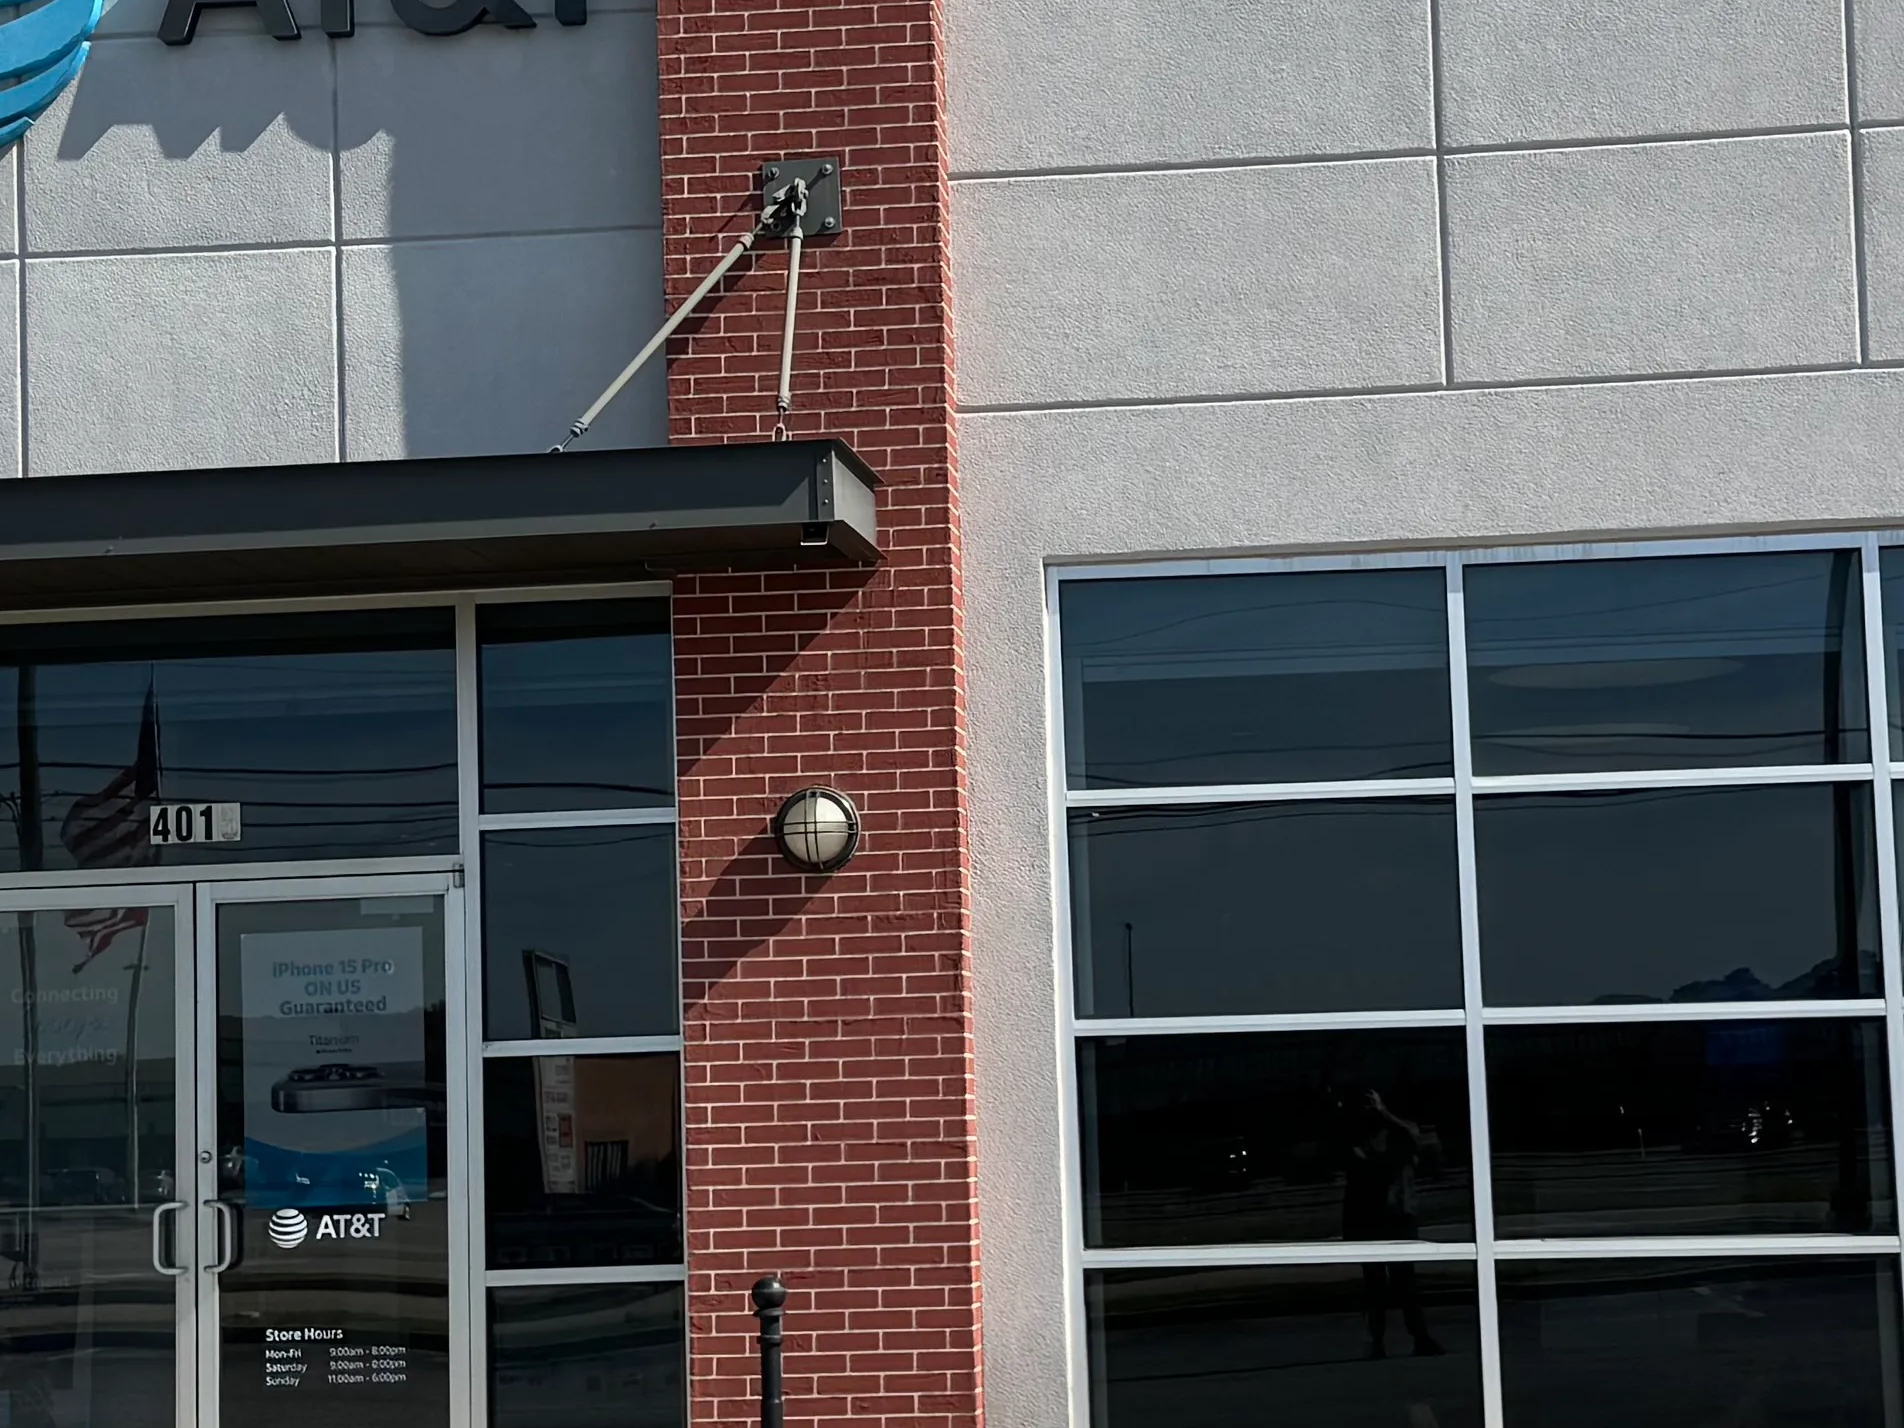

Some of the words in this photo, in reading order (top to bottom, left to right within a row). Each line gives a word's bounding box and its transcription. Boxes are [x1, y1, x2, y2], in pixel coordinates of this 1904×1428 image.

[152, 805, 213, 843] 401
[272, 959, 334, 979] iPhone
[338, 959, 357, 974] 15
[361, 958, 393, 974] Pro
[10, 985, 119, 1005] Connecting
[304, 981, 332, 997] ON
[337, 979, 361, 995] US
[279, 995, 387, 1016] Guaranteed
[13, 1045, 119, 1068] Everything
[315, 1213, 386, 1239] AT&T
[265, 1328, 302, 1341] Store
[304, 1328, 344, 1340] Hours
[265, 1348, 302, 1359] Mon-Fri
[265, 1362, 308, 1374] Saturday
[265, 1376, 300, 1387] Sunday
